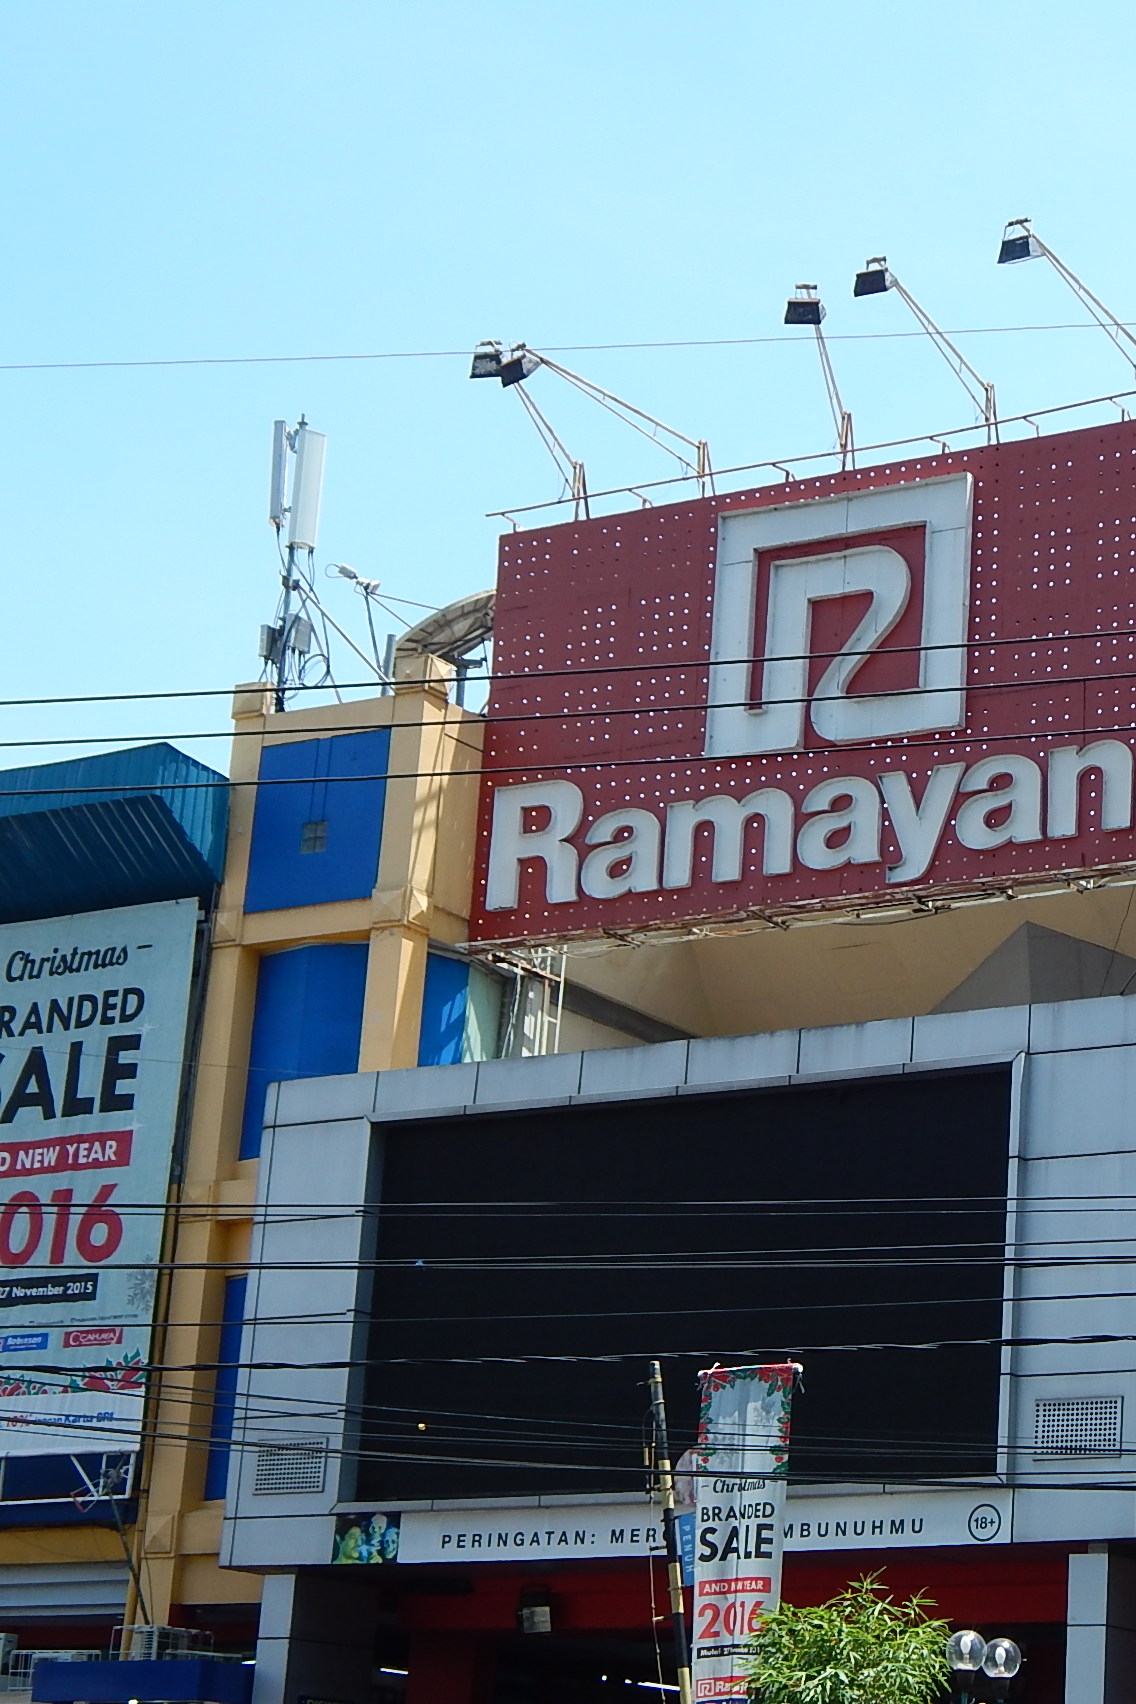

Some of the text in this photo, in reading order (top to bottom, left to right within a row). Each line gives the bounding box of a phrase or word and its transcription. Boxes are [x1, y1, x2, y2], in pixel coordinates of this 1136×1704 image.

[5, 944, 129, 983] Christmas
[0, 987, 146, 1038] RANDED
[0, 1033, 143, 1125] ALE
[15, 1145, 59, 1170] NEW
[65, 1140, 118, 1165] YEAR
[0, 1183, 124, 1267] 016
[12, 1284, 65, 1298] November
[66, 1281, 94, 1295] 2015
[701, 1502, 776, 1523] BRANDED
[973, 1516, 997, 1530] 18+
[441, 1530, 597, 1549] PERINGATAN:
[783, 1517, 925, 1539] MBUNUHMU
[681, 1525, 695, 1573] PENUH
[698, 1523, 775, 1563] SALE
[703, 1582, 729, 1594] AND
[698, 1601, 768, 1640] 2016
